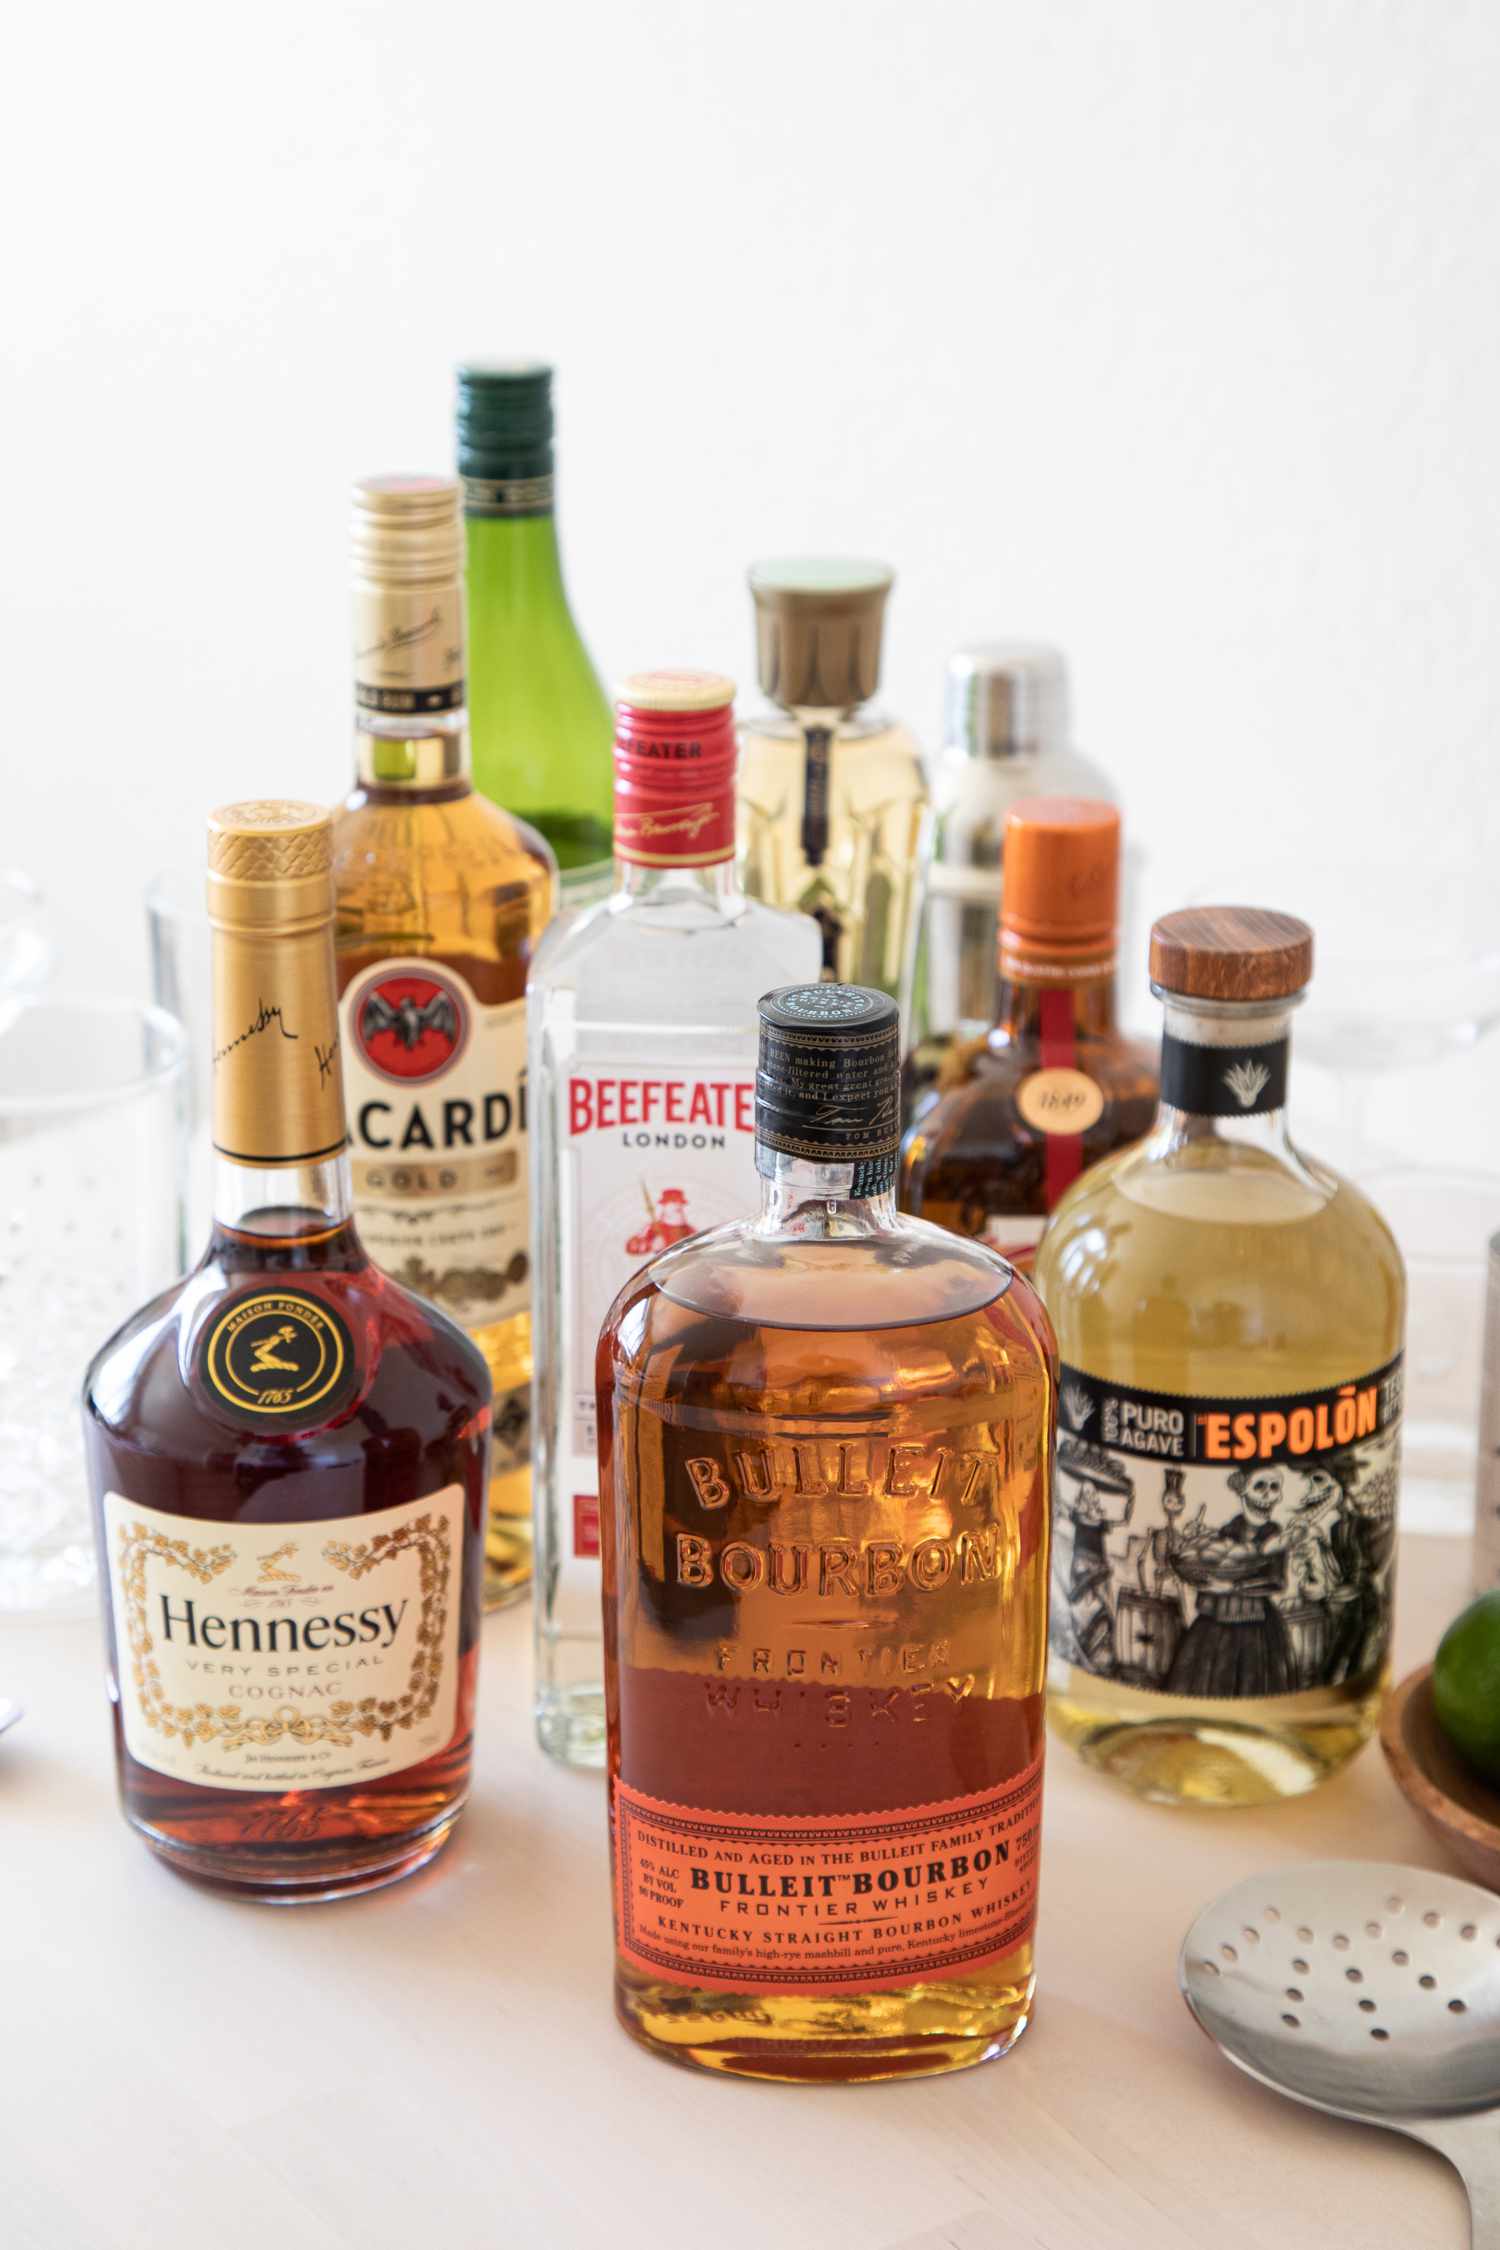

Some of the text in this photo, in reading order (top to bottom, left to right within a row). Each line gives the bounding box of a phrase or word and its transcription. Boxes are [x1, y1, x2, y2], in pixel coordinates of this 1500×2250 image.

[569, 1078, 755, 1136] BEEFEATE
[622, 1132, 726, 1149] LONDON
[366, 1168, 457, 1191] GOLD
[1121, 1400, 1184, 1435] PURO
[1121, 1427, 1184, 1456] AGAVE
[685, 1441, 1000, 1511] BULLEIT
[676, 1522, 1002, 1597] BOURBON
[159, 1593, 408, 1653] Hennessy
[186, 1655, 384, 1677] VERY SPECIAL
[228, 1681, 343, 1700] COGNAC
[638, 1830, 708, 1859] DISTILLED
[714, 1850, 743, 1863] AND
[750, 1854, 794, 1866] AGED
[801, 1856, 816, 1866] IN
[822, 1853, 854, 1866] THE
[860, 1843, 926, 1863] BULLEIT
[931, 1828, 984, 1852] FAMILY
[659, 1865, 680, 1879] ALC
[854, 1840, 1009, 1895] BOURBON
[650, 1890, 684, 1909] PROOF
[658, 1880, 1032, 1945] KENTUCKY STRAIGHT BOURBON WHISKEY
[720, 1877, 988, 1916] FRONTIER WHISKEY
[692, 1943, 709, 1954] our
[713, 1943, 752, 1959] family's
[756, 1947, 801, 1961] high-rye
[805, 1944, 851, 1960] mashbill
[854, 1943, 875, 1957] and
[908, 1931, 956, 1949] Kentucky
